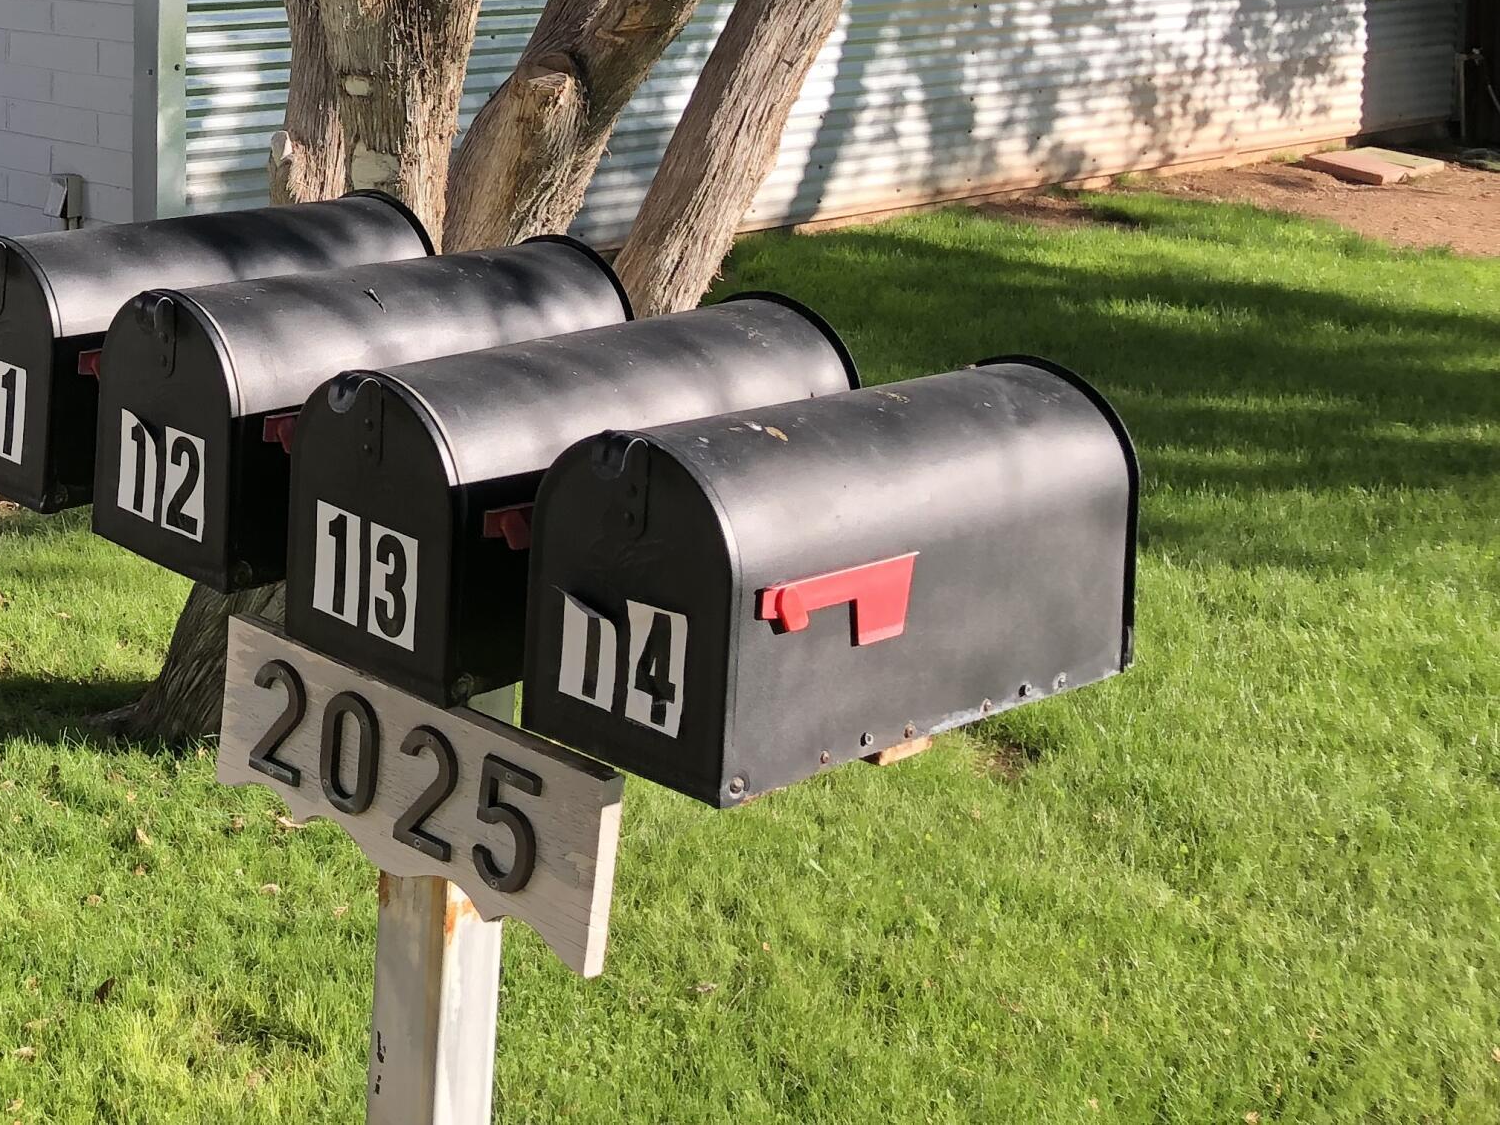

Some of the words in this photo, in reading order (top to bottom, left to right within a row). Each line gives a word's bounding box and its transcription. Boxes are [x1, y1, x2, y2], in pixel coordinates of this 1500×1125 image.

[131, 421, 201, 537] 12
[328, 513, 407, 639] 13
[581, 611, 677, 727] 14
[248, 658, 543, 894] 2025
